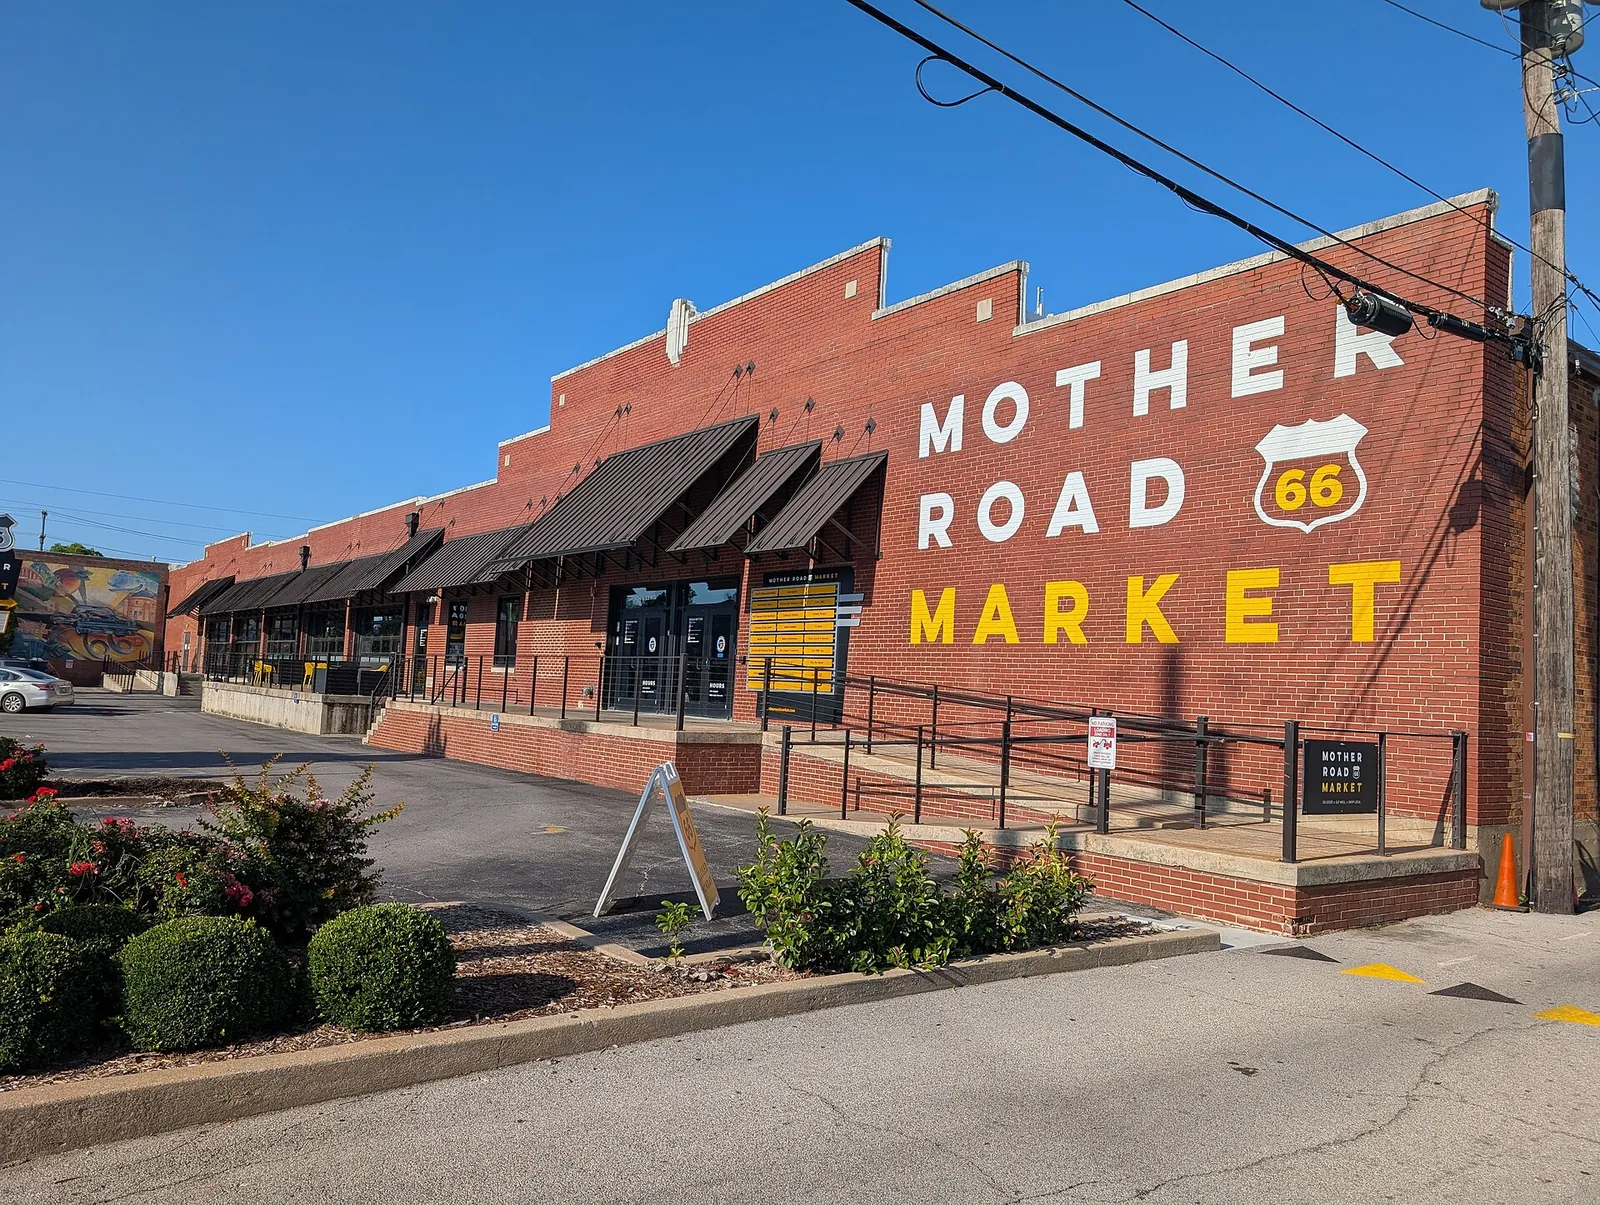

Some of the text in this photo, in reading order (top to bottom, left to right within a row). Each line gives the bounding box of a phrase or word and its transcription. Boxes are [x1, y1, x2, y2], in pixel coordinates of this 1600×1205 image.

[918, 304, 1405, 459] MOTHER
[917, 456, 1344, 551] ROAD 66
[769, 576, 790, 584] MOTHER
[910, 560, 1402, 645] MARKET
[1322, 751, 1362, 762] MOTHER
[1322, 766, 1349, 777] ROAD
[1322, 782, 1362, 792] MARKET
